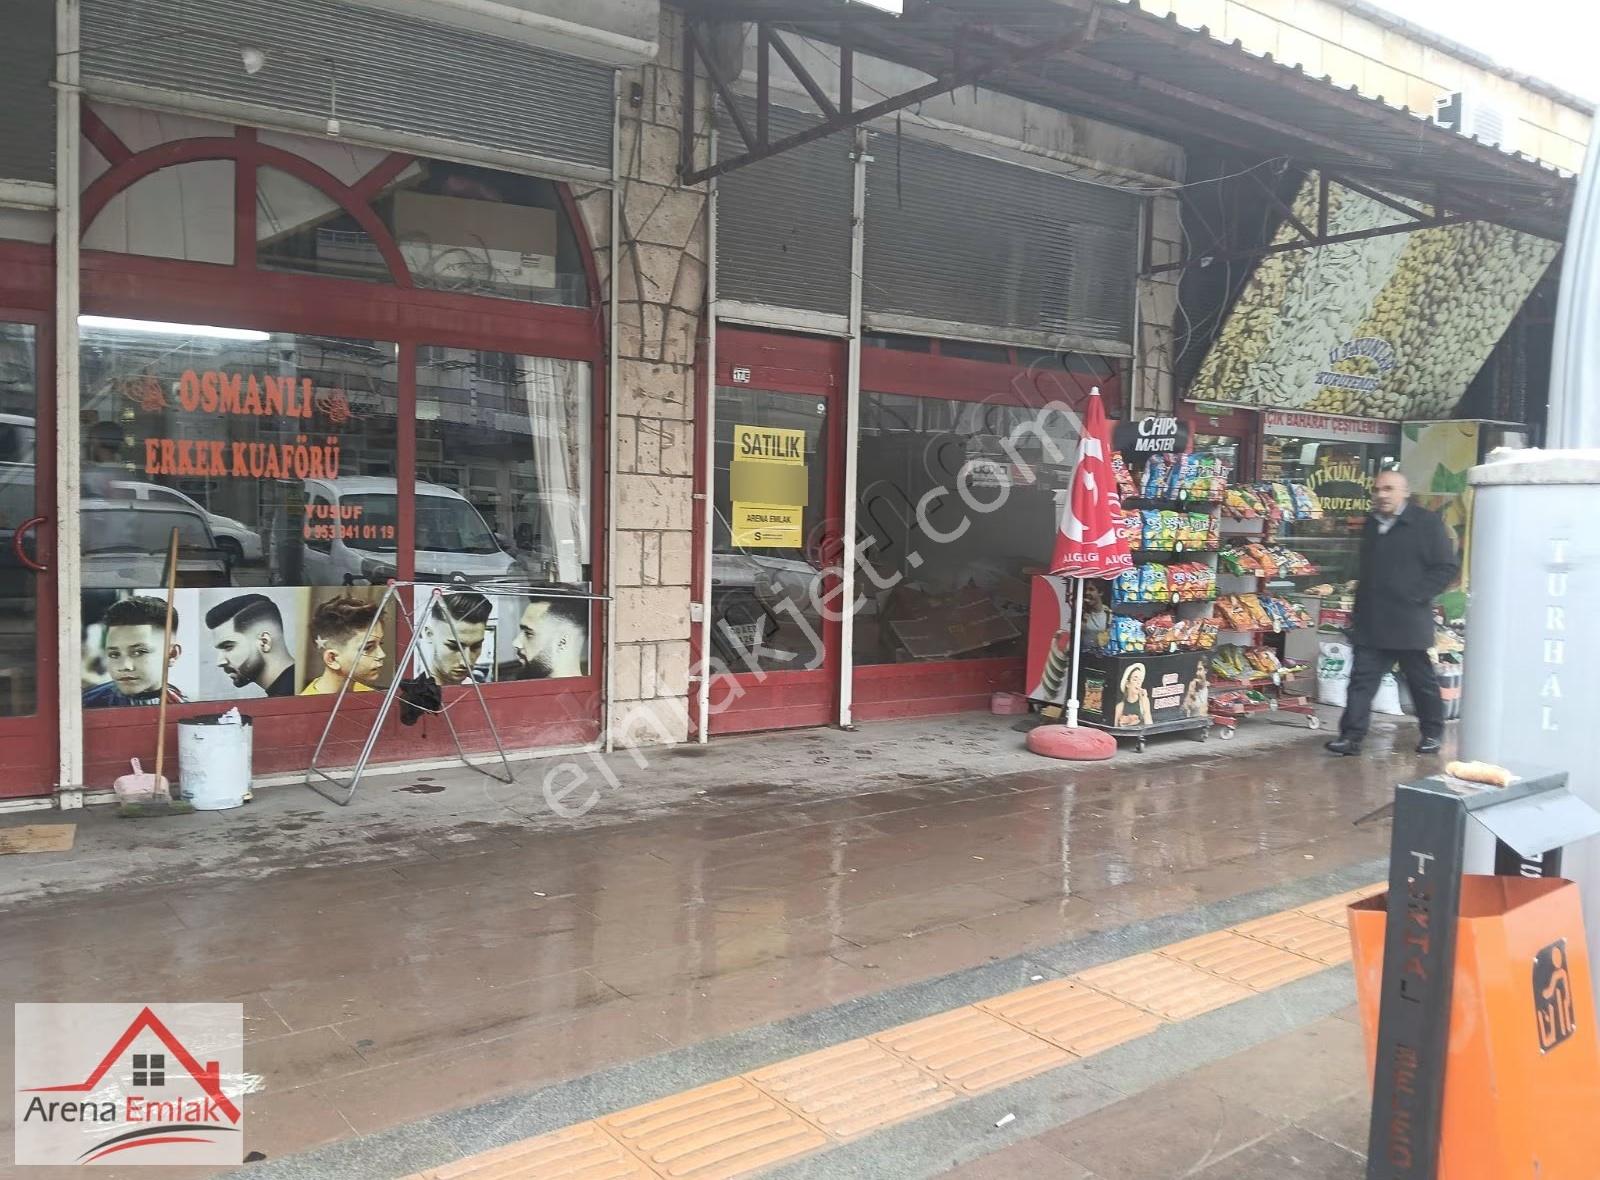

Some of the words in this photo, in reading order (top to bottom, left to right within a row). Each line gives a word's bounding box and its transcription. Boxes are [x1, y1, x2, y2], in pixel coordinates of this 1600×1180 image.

[180, 369, 313, 418] OSMANLI
[1138, 416, 1177, 436] CHIPS
[741, 432, 800, 458] SATILIK
[1135, 438, 1176, 452] MASTER
[145, 438, 226, 477] ERKEK
[232, 434, 340, 480] KUAFÖRÜ
[304, 504, 363, 519] YUSUF
[746, 514, 768, 523] ARENA
[769, 515, 792, 524] EMLAK
[363, 524, 377, 539] 01
[381, 525, 395, 539] 19
[1540, 537, 1569, 731] TURHAL
